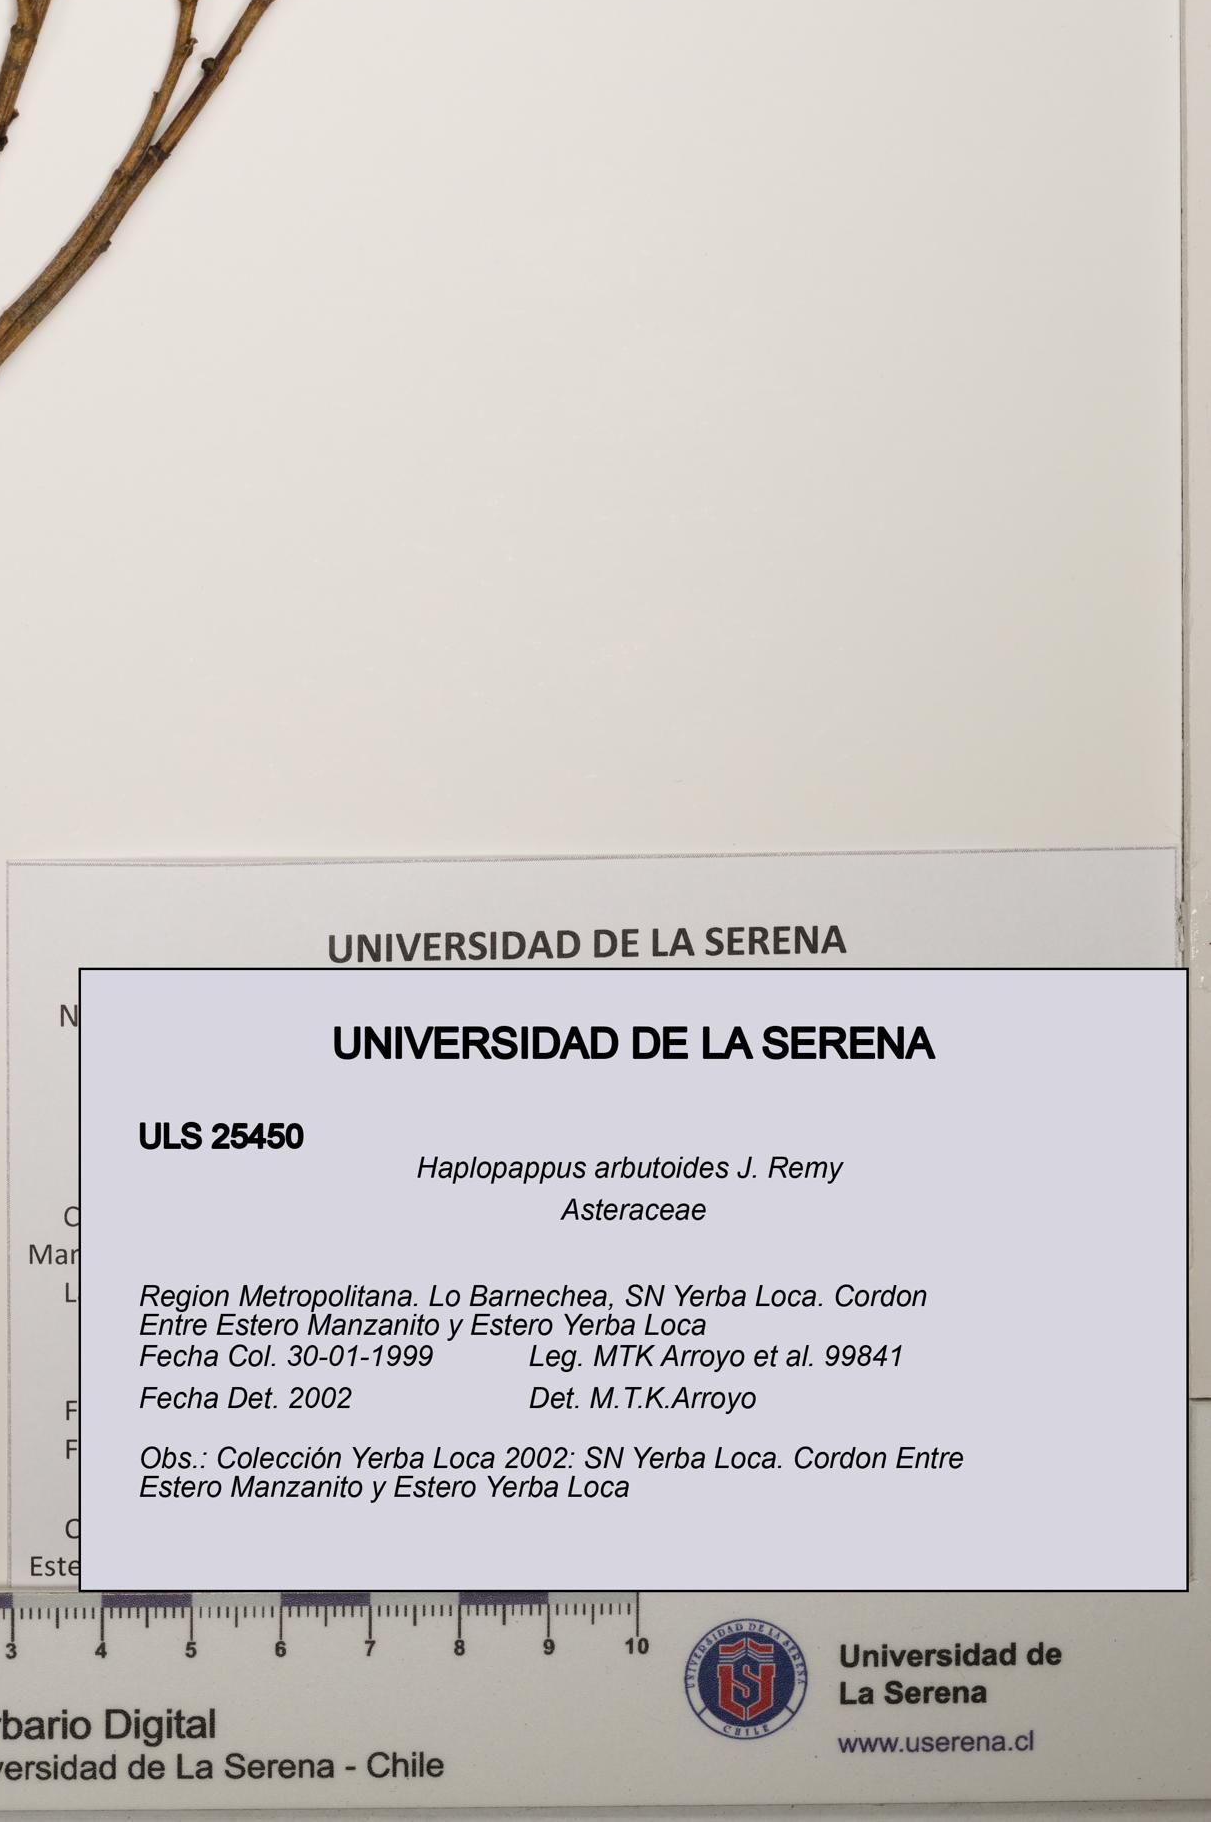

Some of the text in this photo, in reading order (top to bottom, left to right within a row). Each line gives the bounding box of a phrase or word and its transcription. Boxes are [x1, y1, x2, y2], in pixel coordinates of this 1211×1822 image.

[328, 924, 848, 964] UNIVERSIDAD DE LA SERENA
[748, 1622, 765, 1633] DE
[5, 1642, 18, 1660] 3
[94, 1642, 108, 1659] 4
[184, 1641, 198, 1659] 5
[274, 1640, 287, 1658] 6
[364, 1640, 377, 1657] 7
[453, 1639, 466, 1657] 8
[542, 1639, 556, 1656] 9
[624, 1638, 650, 1656] 10
[839, 1641, 1063, 1669] Universidad de
[839, 1679, 988, 1706] La Serena
[104, 1707, 216, 1748] Digital
[722, 1724, 770, 1736] CHILE
[837, 1729, 1035, 1754] www.userena.cl
[127, 1753, 166, 1781] de
[176, 1753, 214, 1780] La
[224, 1752, 335, 1780] Serena
[366, 1750, 445, 1780] Chile
